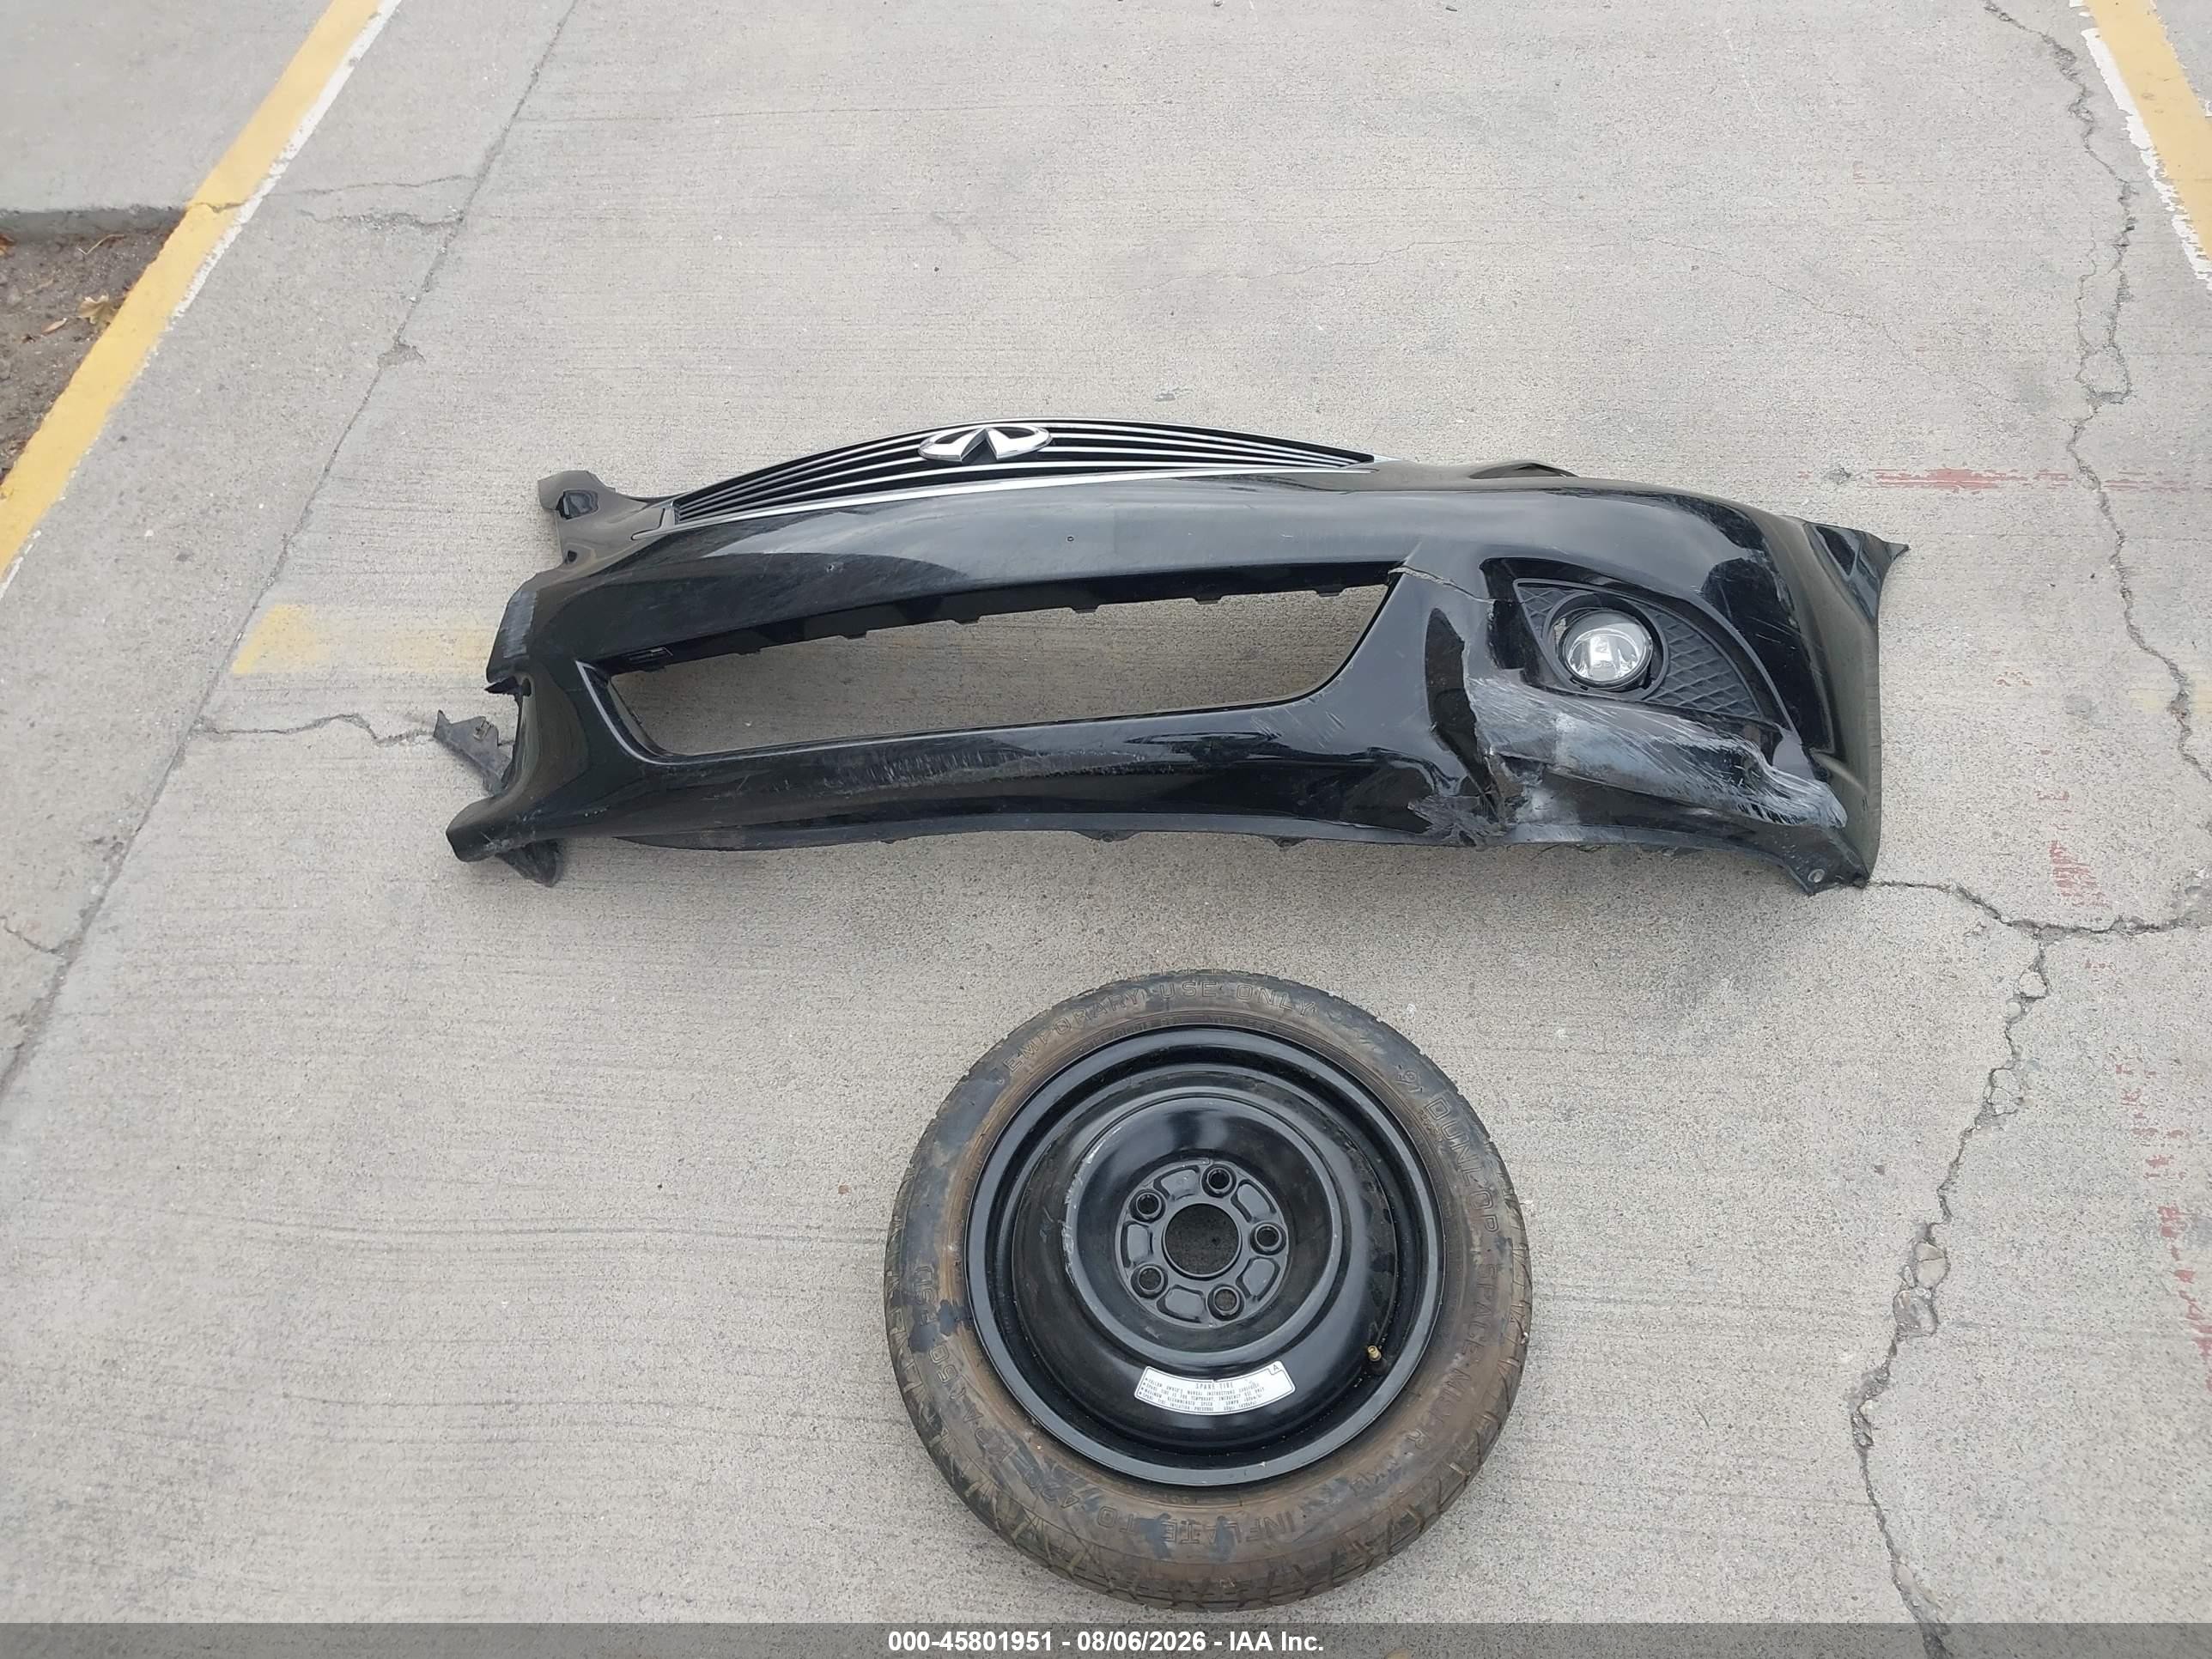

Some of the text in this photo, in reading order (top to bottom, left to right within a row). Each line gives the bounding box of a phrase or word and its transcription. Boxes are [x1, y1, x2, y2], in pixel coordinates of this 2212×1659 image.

[1159, 980, 1217, 1000] USE
[1235, 981, 1319, 1019] ONLY
[1427, 1096, 1498, 1233] DUNLOP
